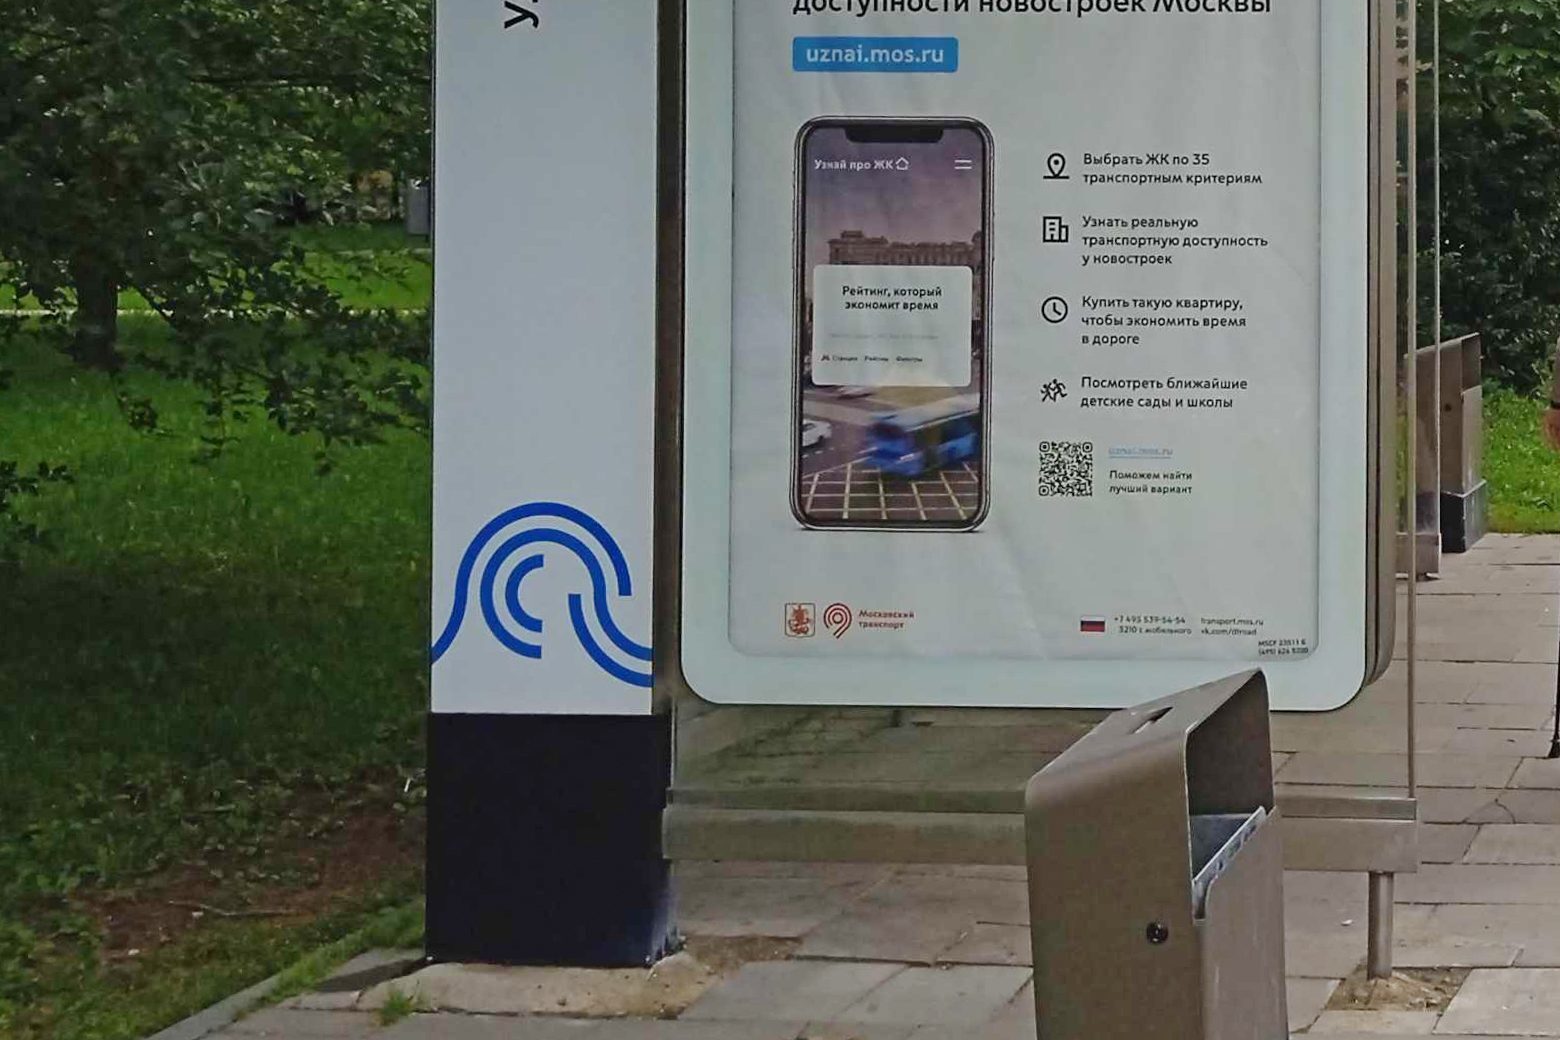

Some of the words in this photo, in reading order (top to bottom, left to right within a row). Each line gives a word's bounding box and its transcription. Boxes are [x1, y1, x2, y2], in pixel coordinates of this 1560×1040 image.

[807, 45, 943, 63] uznai.mos.ru
[812, 158, 847, 170] Узнай
[849, 161, 872, 172] про
[873, 156, 894, 170] ЖК
[1083, 152, 1144, 169] Выбрать
[1145, 153, 1170, 166] ЖК
[1172, 155, 1190, 166] по
[1192, 153, 1210, 166] 35
[1081, 173, 1184, 186] транспортным
[1185, 174, 1262, 187] критериям
[1081, 215, 1130, 231] Узнать
[1130, 218, 1199, 231] реальную
[1081, 236, 1180, 250] транспортную
[1181, 236, 1269, 249] доступность
[1081, 254, 1091, 267] у
[1093, 254, 1173, 267] новостроек
[842, 285, 892, 298] Рейтинг,
[893, 286, 942, 300] который
[844, 301, 901, 310] экономит
[902, 301, 939, 313] время
[1081, 295, 1131, 311] Купить
[1131, 298, 1174, 312] такую
[1175, 299, 1243, 312] квартиру,
[1081, 313, 1124, 331] чтобы
[1125, 316, 1200, 327] экономить
[1202, 317, 1246, 329] время
[1081, 335, 1090, 345] в
[1091, 334, 1140, 348] дороге
[1080, 375, 1164, 392] Посмотреть
[1166, 376, 1248, 390] ближайшие
[1080, 397, 1135, 408] детские
[1136, 397, 1172, 409] сады
[1175, 398, 1184, 408] и
[1186, 396, 1233, 408] школы
[1109, 470, 1159, 480] Поможем
[1163, 471, 1192, 480] найти
[1109, 484, 1148, 494] лучший
[1151, 486, 1192, 495] вариант
[859, 610, 914, 618] Московский
